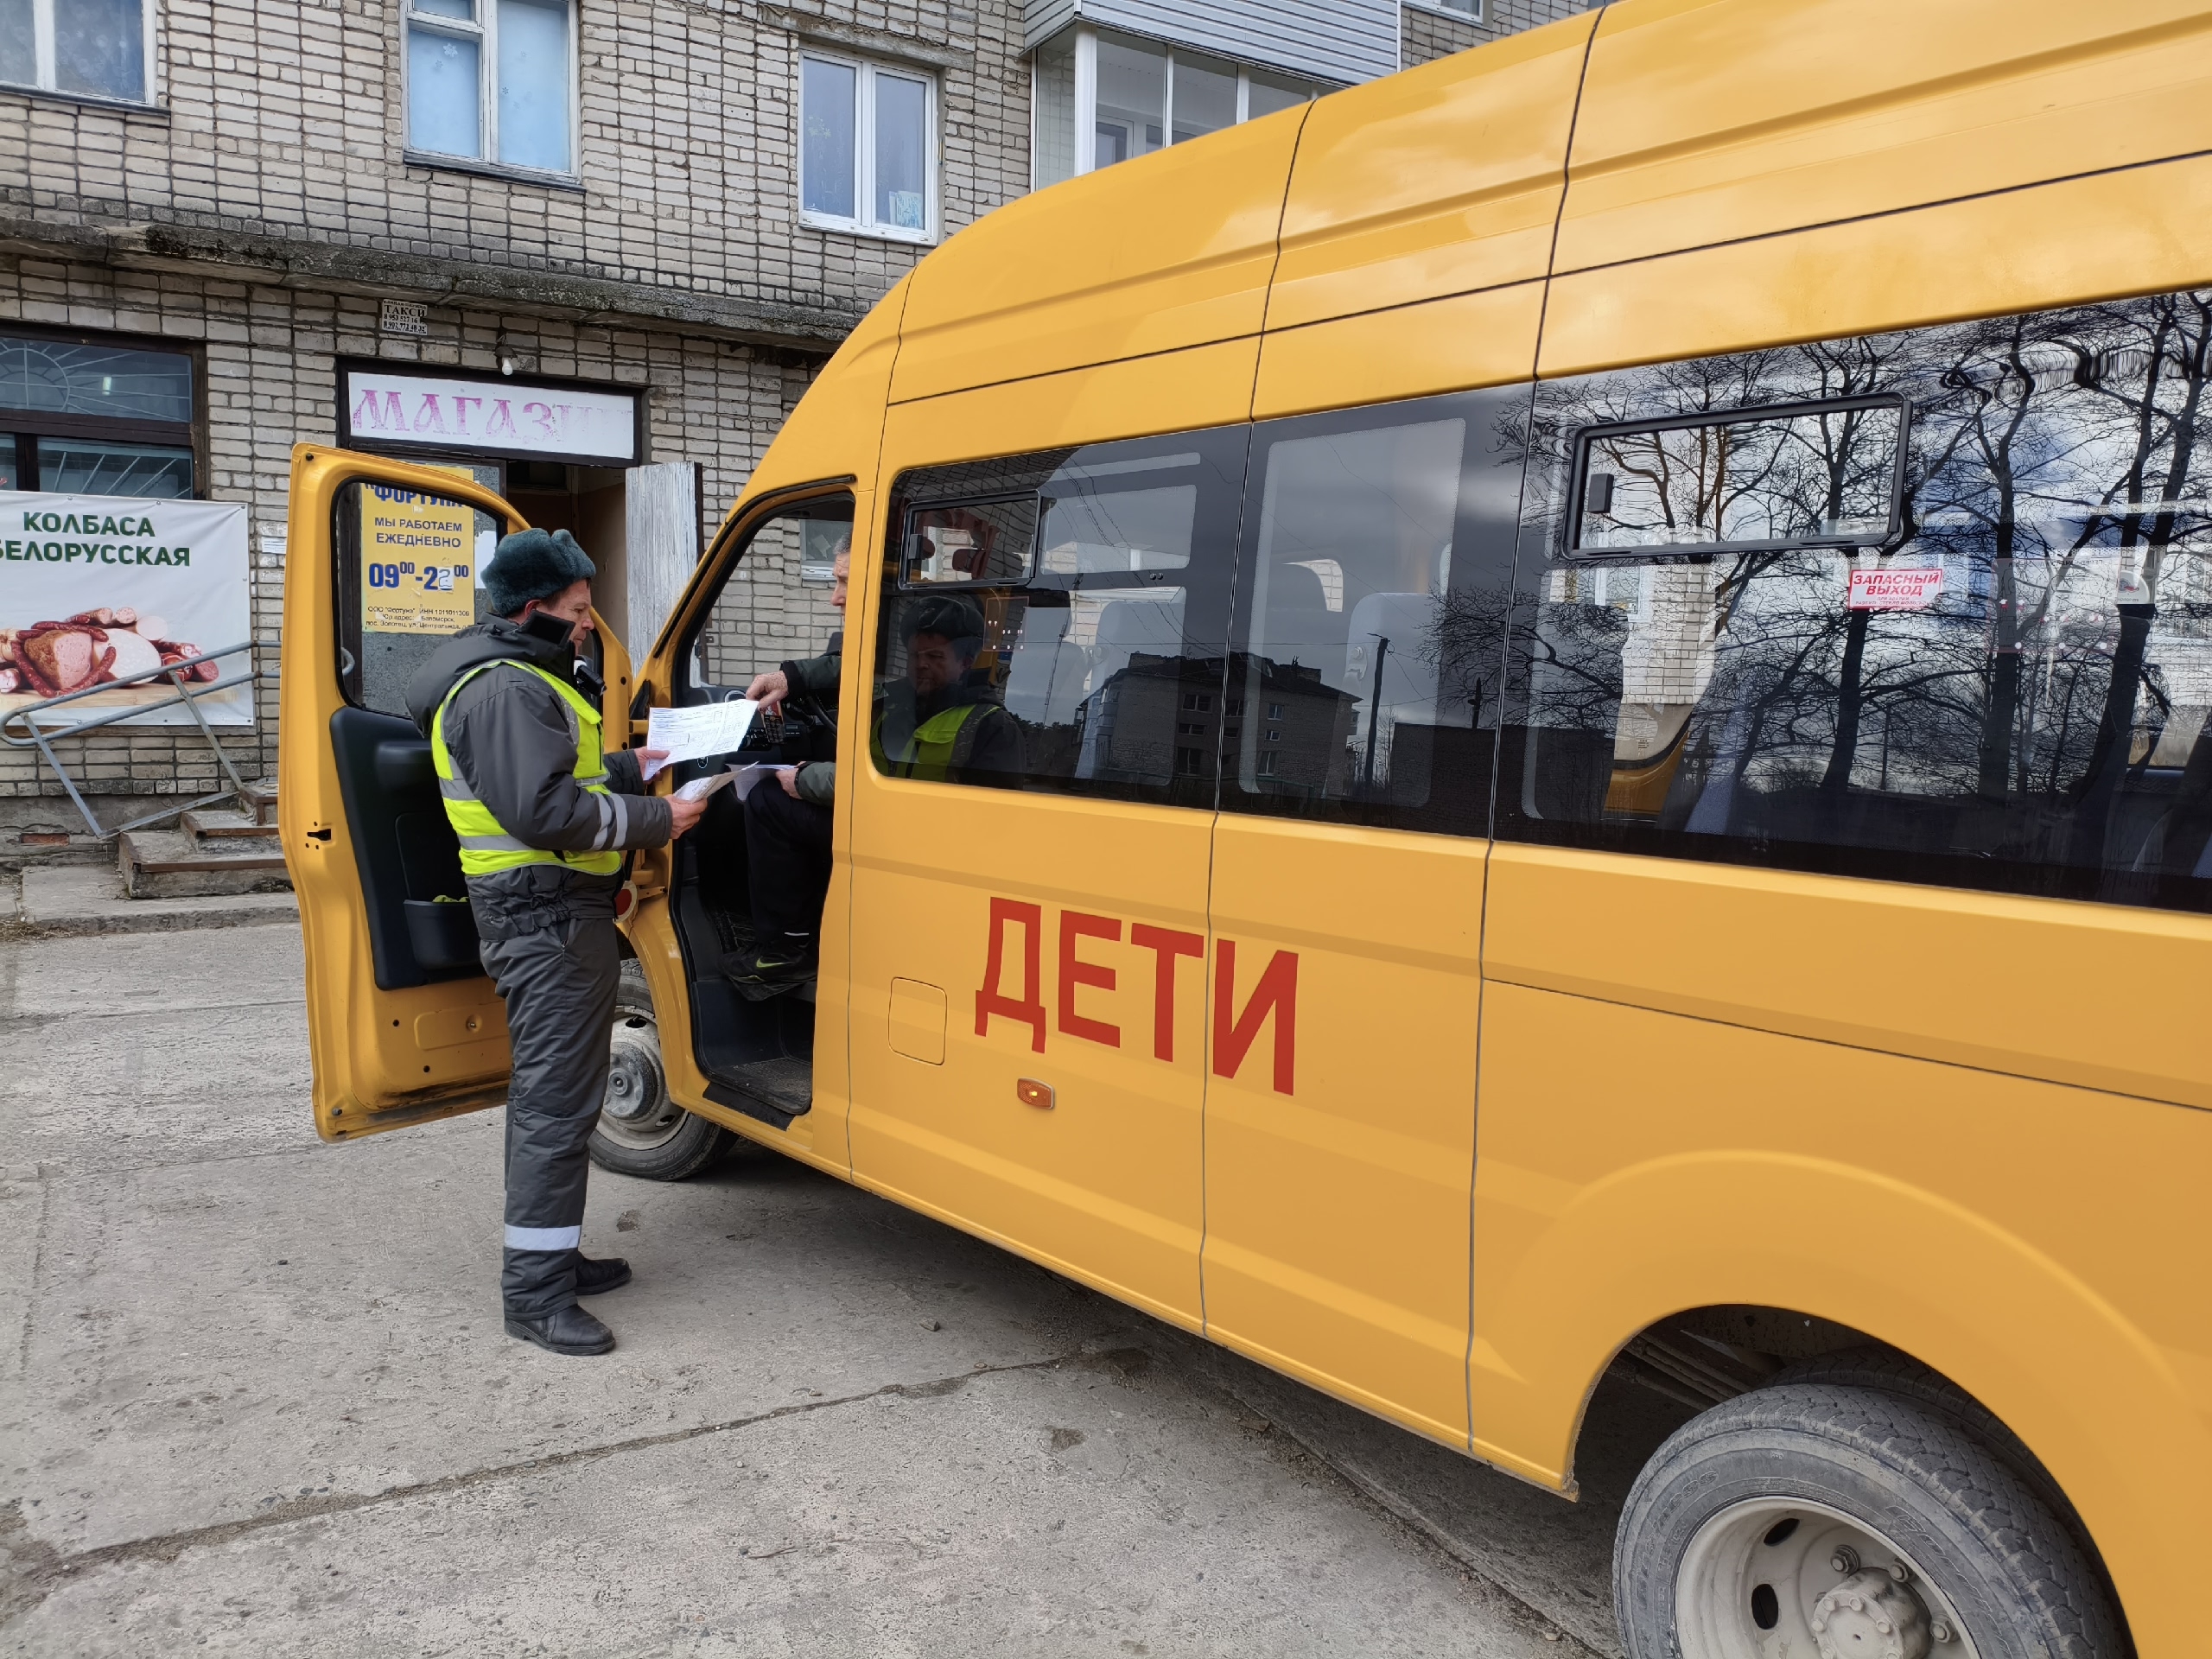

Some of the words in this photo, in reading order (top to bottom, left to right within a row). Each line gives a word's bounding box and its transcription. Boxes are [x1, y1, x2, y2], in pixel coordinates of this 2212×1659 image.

[384, 304, 425, 317] ТАКСИ
[23, 512, 156, 537] КОЛБАСА
[374, 518, 396, 527] МЫ
[399, 518, 462, 532] РАБОТАЕМ
[376, 532, 461, 548] ЕЖЕДНЕВНО
[0, 538, 190, 567] ЕЛОРУССКАЯ
[1853, 572, 1940, 585] ЗАПАСНЫЙ
[1866, 585, 1923, 596] ВЫХОД
[975, 897, 1299, 1096] ДЕТИ
